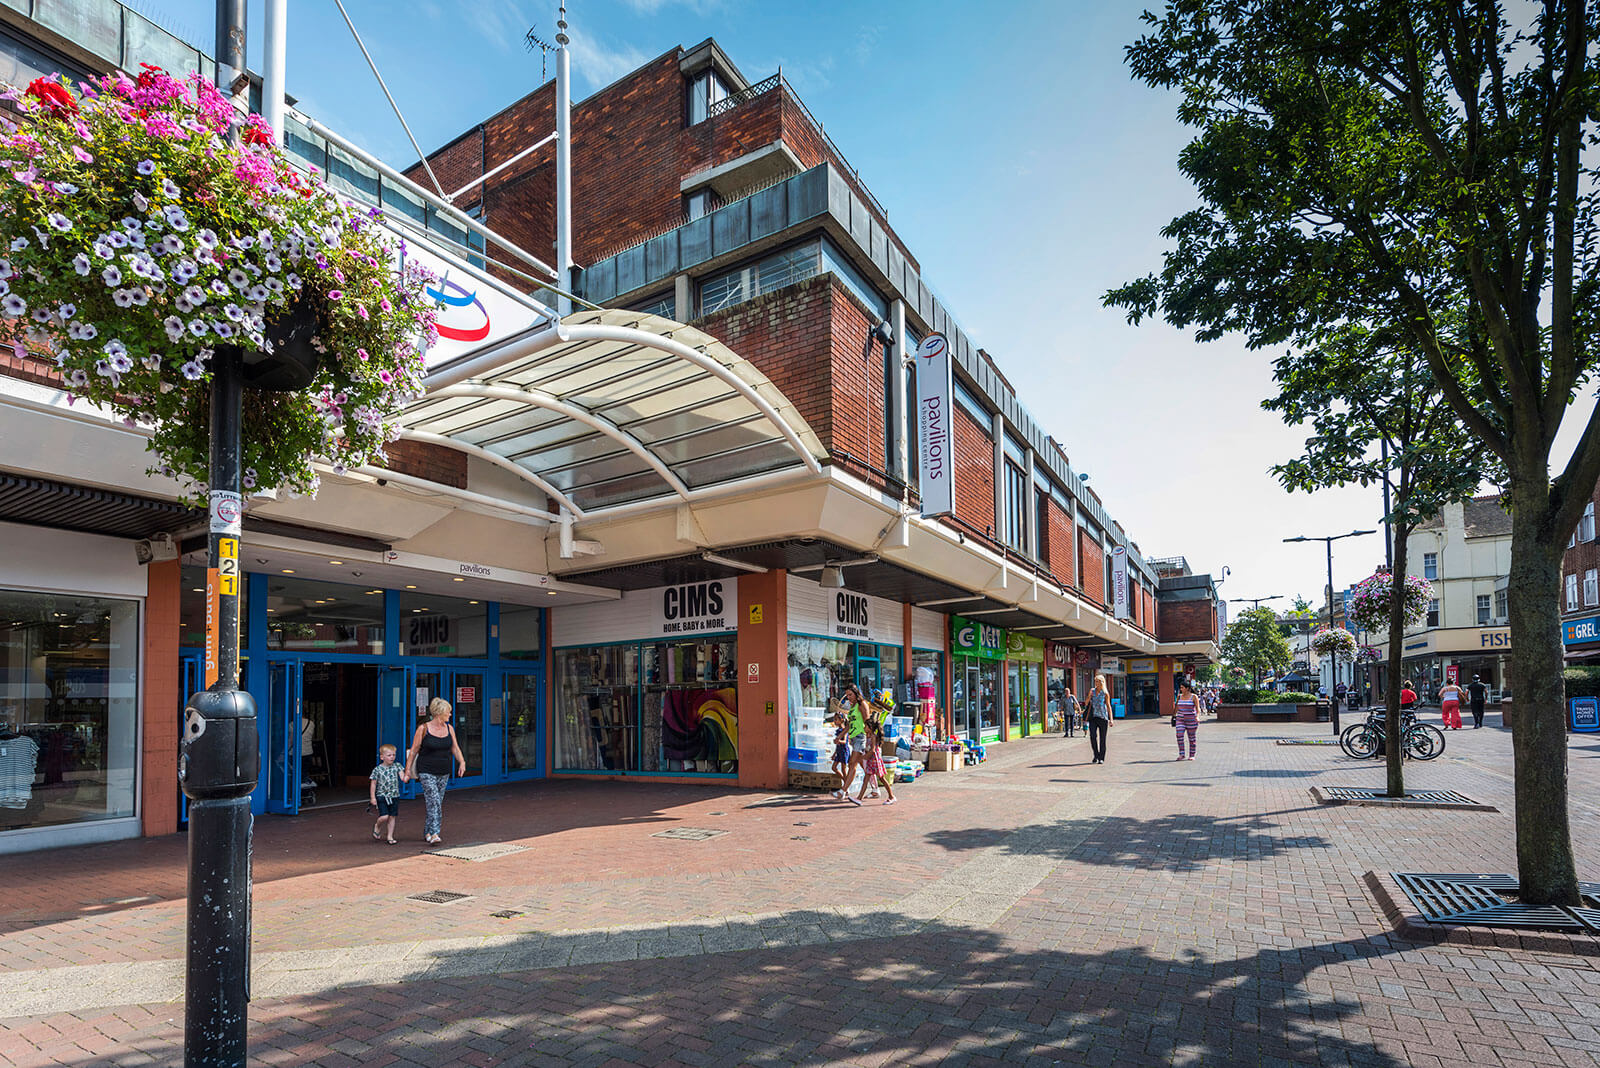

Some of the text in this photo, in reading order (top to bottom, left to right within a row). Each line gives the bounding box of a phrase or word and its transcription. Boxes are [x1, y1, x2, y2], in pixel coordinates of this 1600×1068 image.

[923, 396, 946, 479] pavilions
[460, 564, 491, 575] pavilions
[664, 581, 723, 620] CIMS
[836, 591, 868, 626] CIMS
[663, 618, 724, 632] HOME, BABY & MORE
